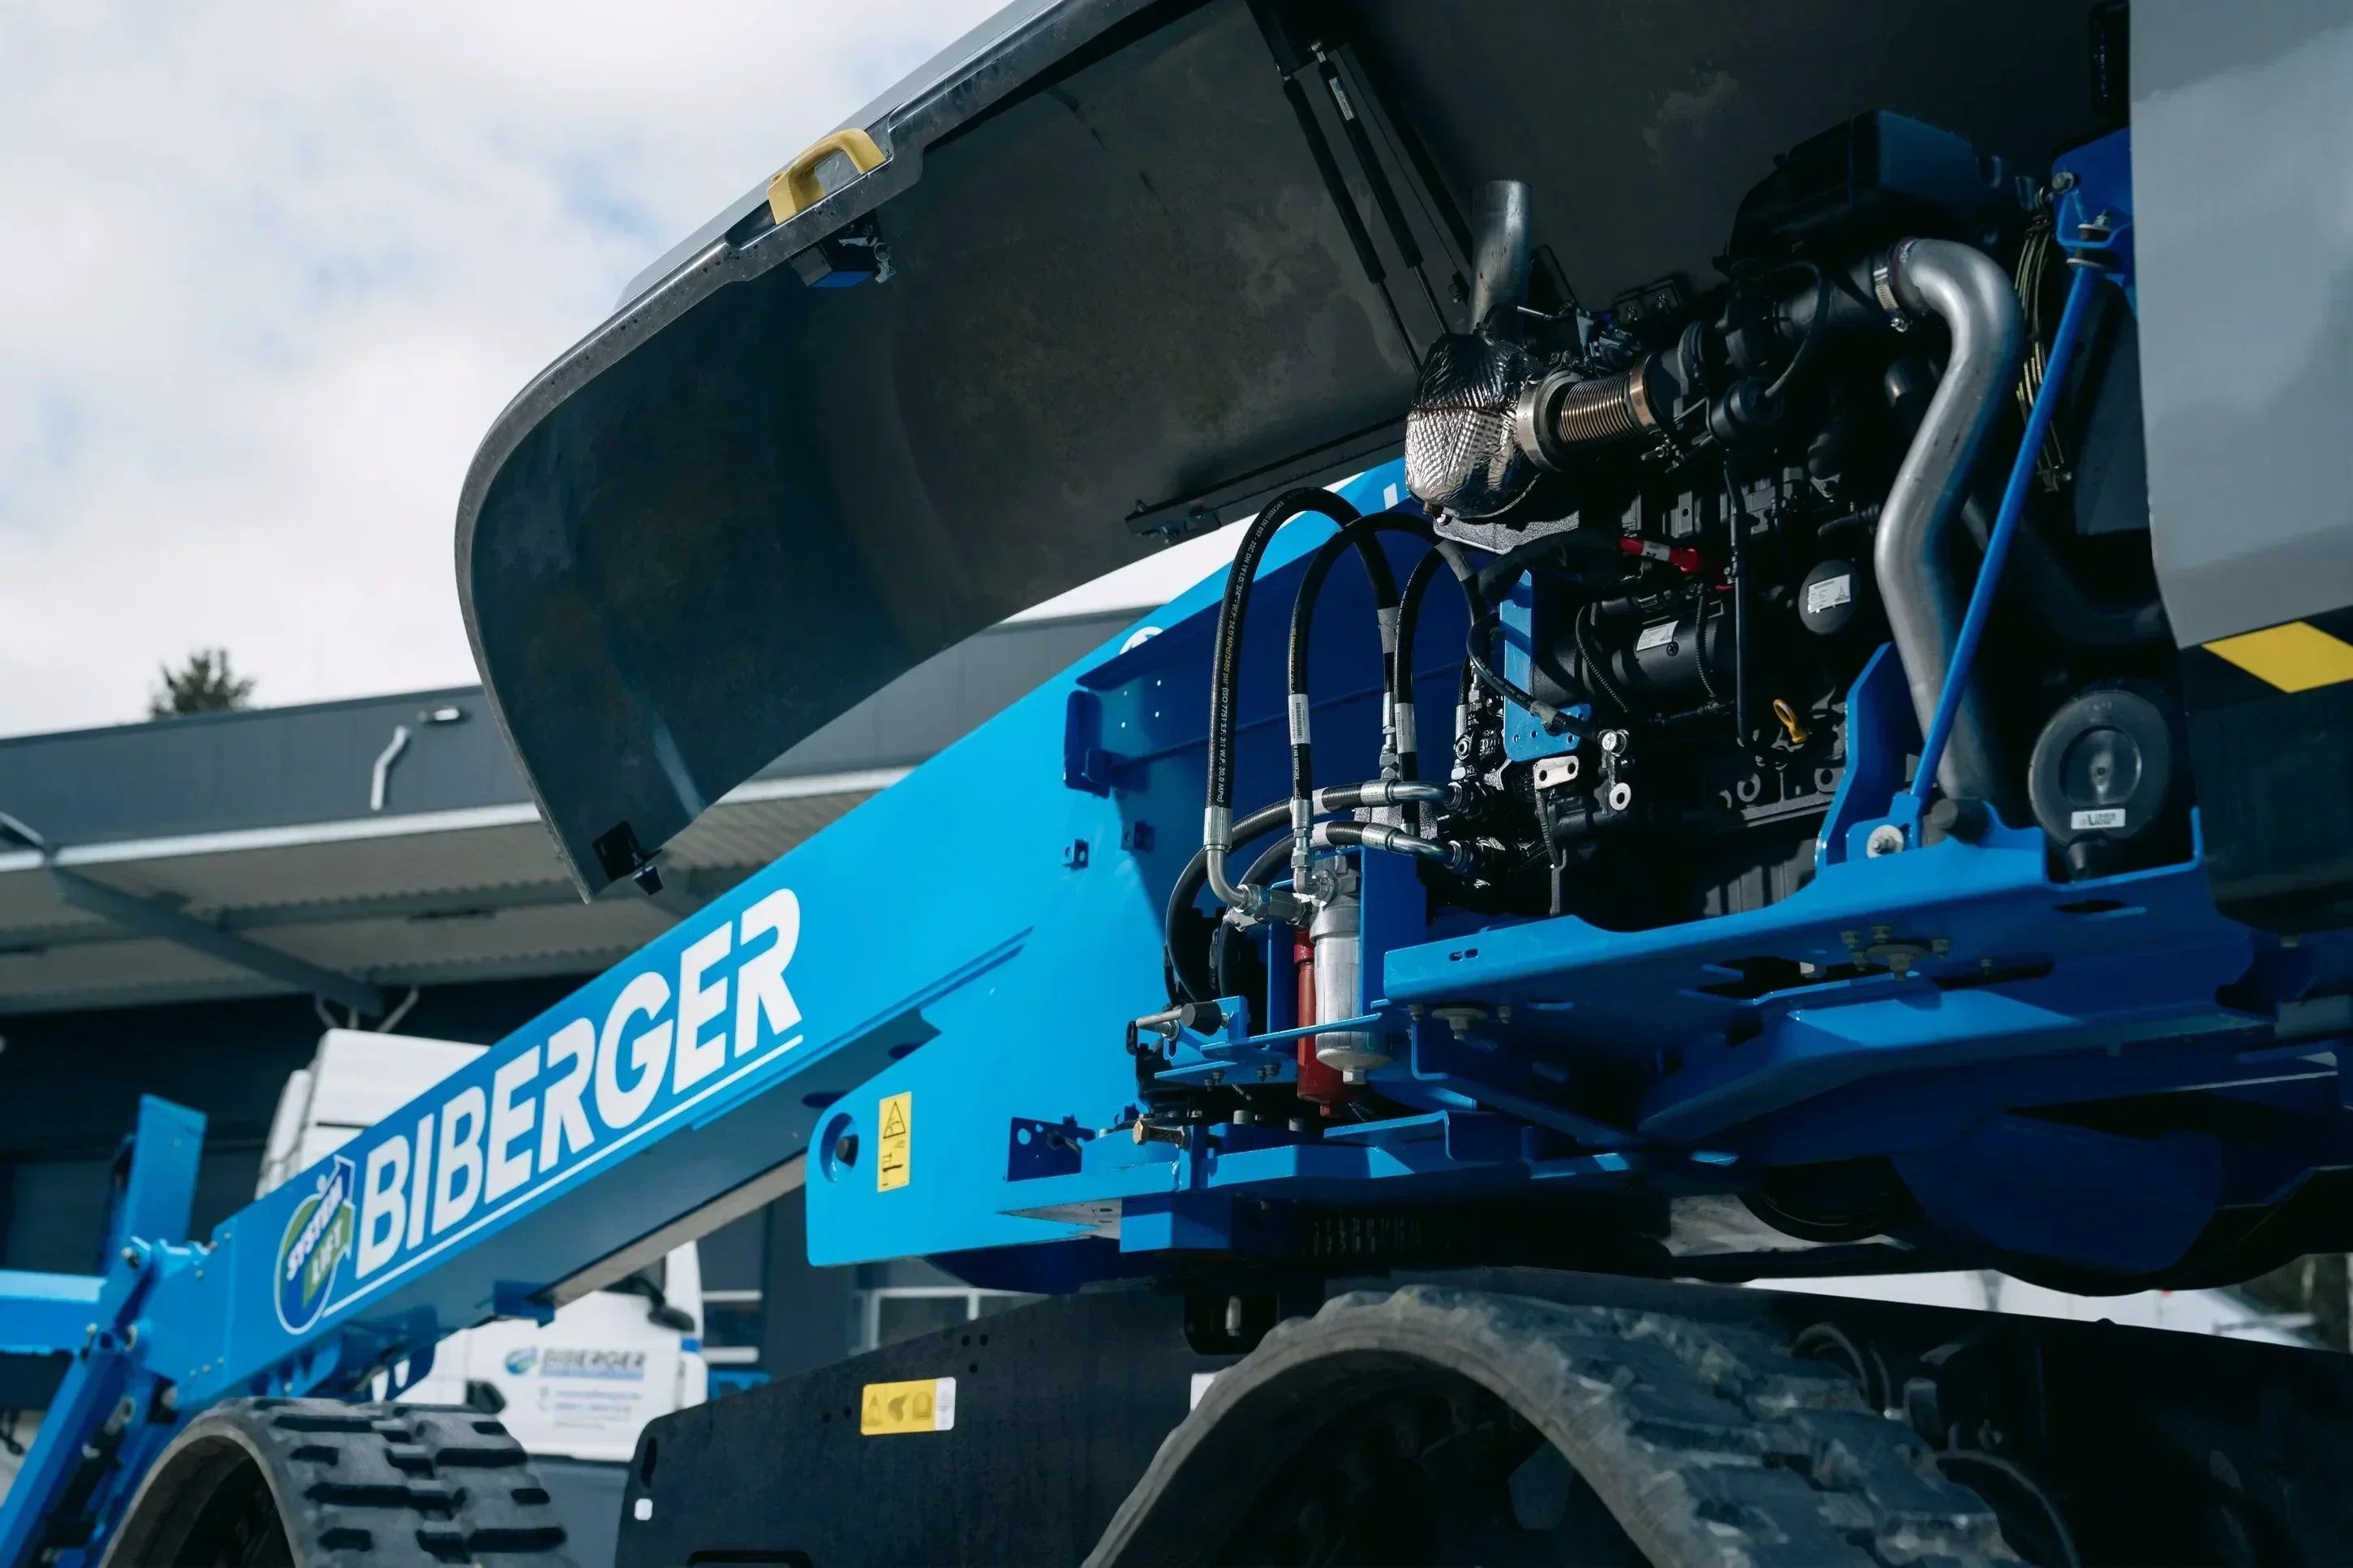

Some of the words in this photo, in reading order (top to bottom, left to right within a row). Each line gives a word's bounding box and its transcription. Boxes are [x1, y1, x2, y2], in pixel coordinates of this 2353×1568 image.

[1266, 500, 1284, 520] EXCEEDS
[1261, 518, 1269, 526] EN
[1256, 526, 1264, 538] 857
[1244, 552, 1252, 564] DN
[1230, 604, 1238, 618] W.P.
[1221, 687, 1229, 703] (ISO
[1216, 784, 1224, 803] MPa)
[355, 888, 802, 1279] BIBERGER
